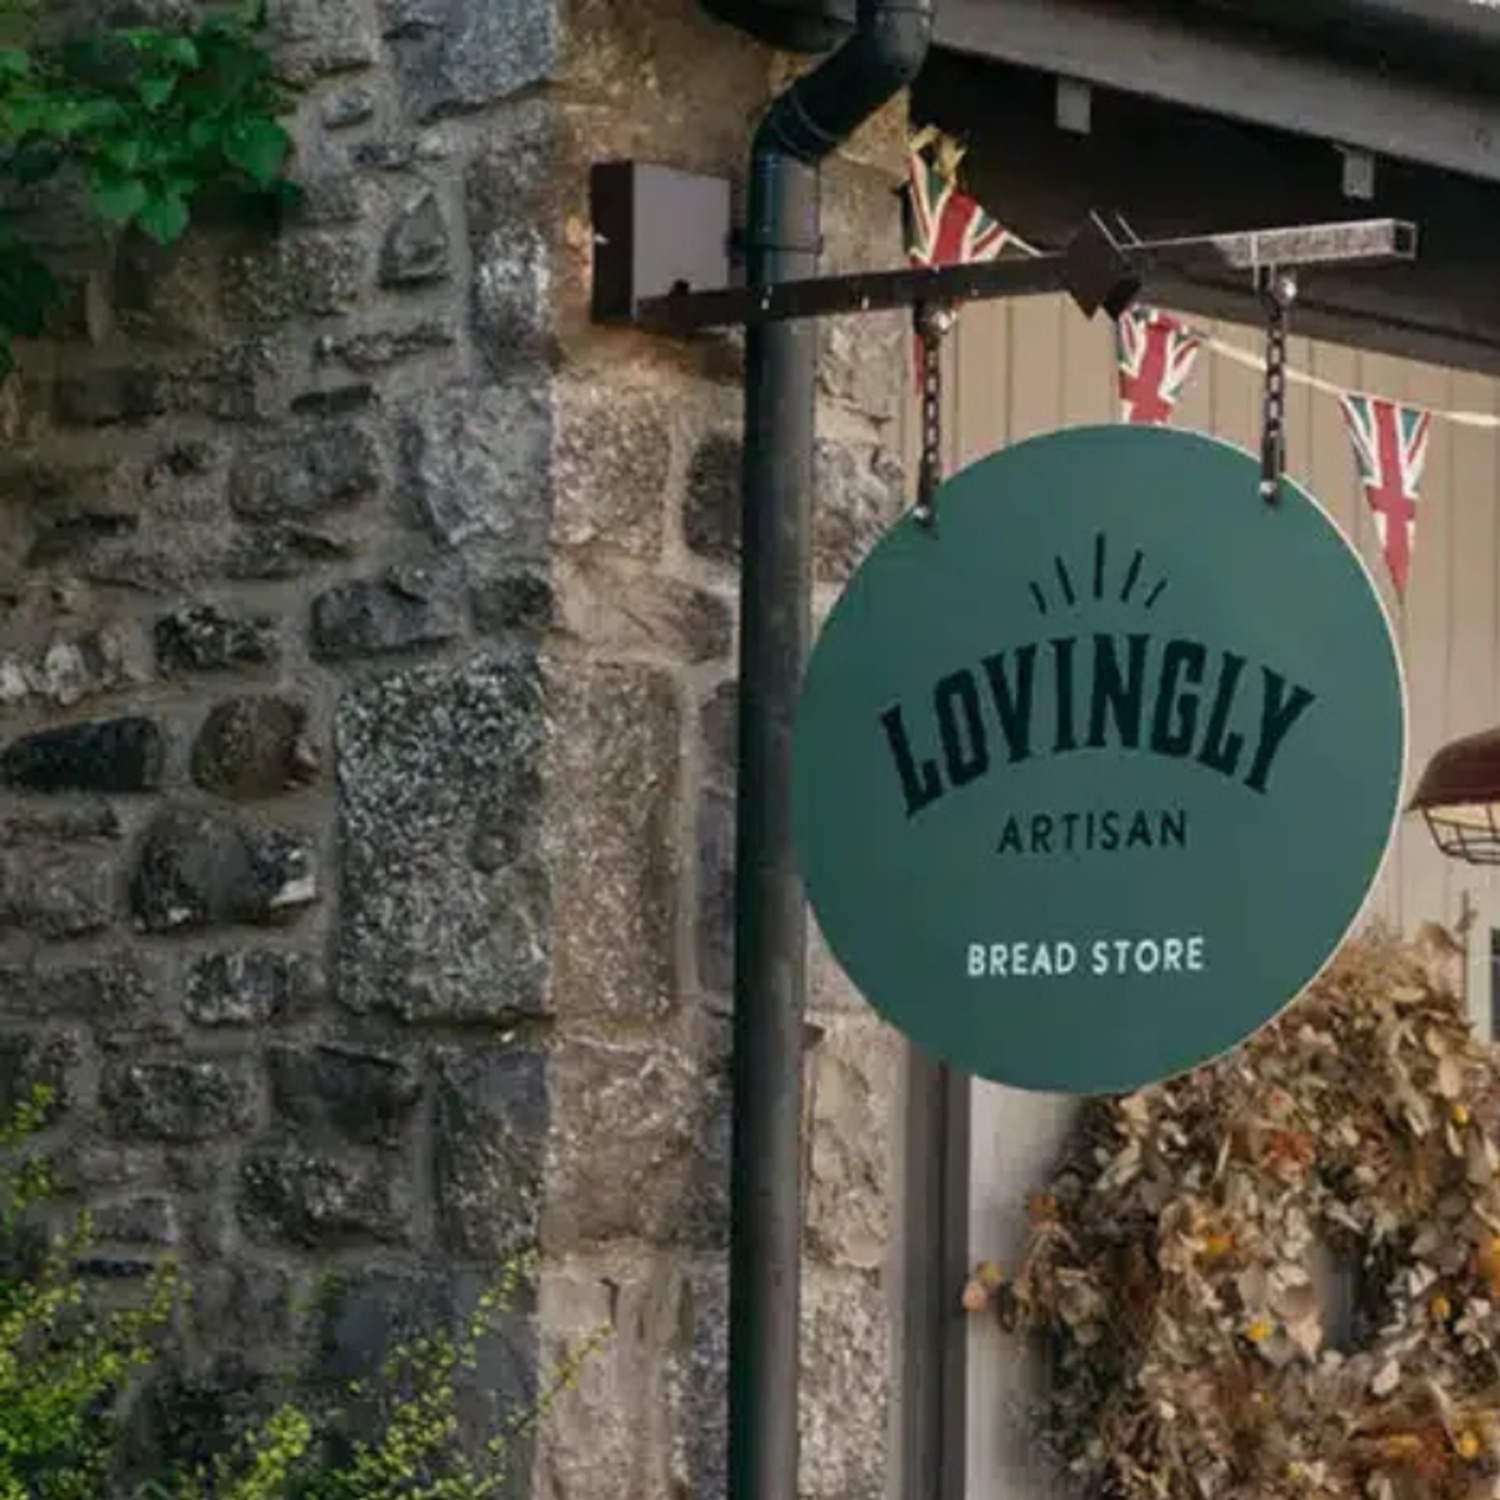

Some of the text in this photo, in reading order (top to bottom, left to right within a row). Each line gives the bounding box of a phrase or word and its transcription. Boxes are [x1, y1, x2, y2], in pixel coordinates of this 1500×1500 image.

[878, 631, 1317, 819] LOVINGLY
[996, 809, 1188, 855] ARTISAN
[966, 937, 1206, 977] BREAD STORE
